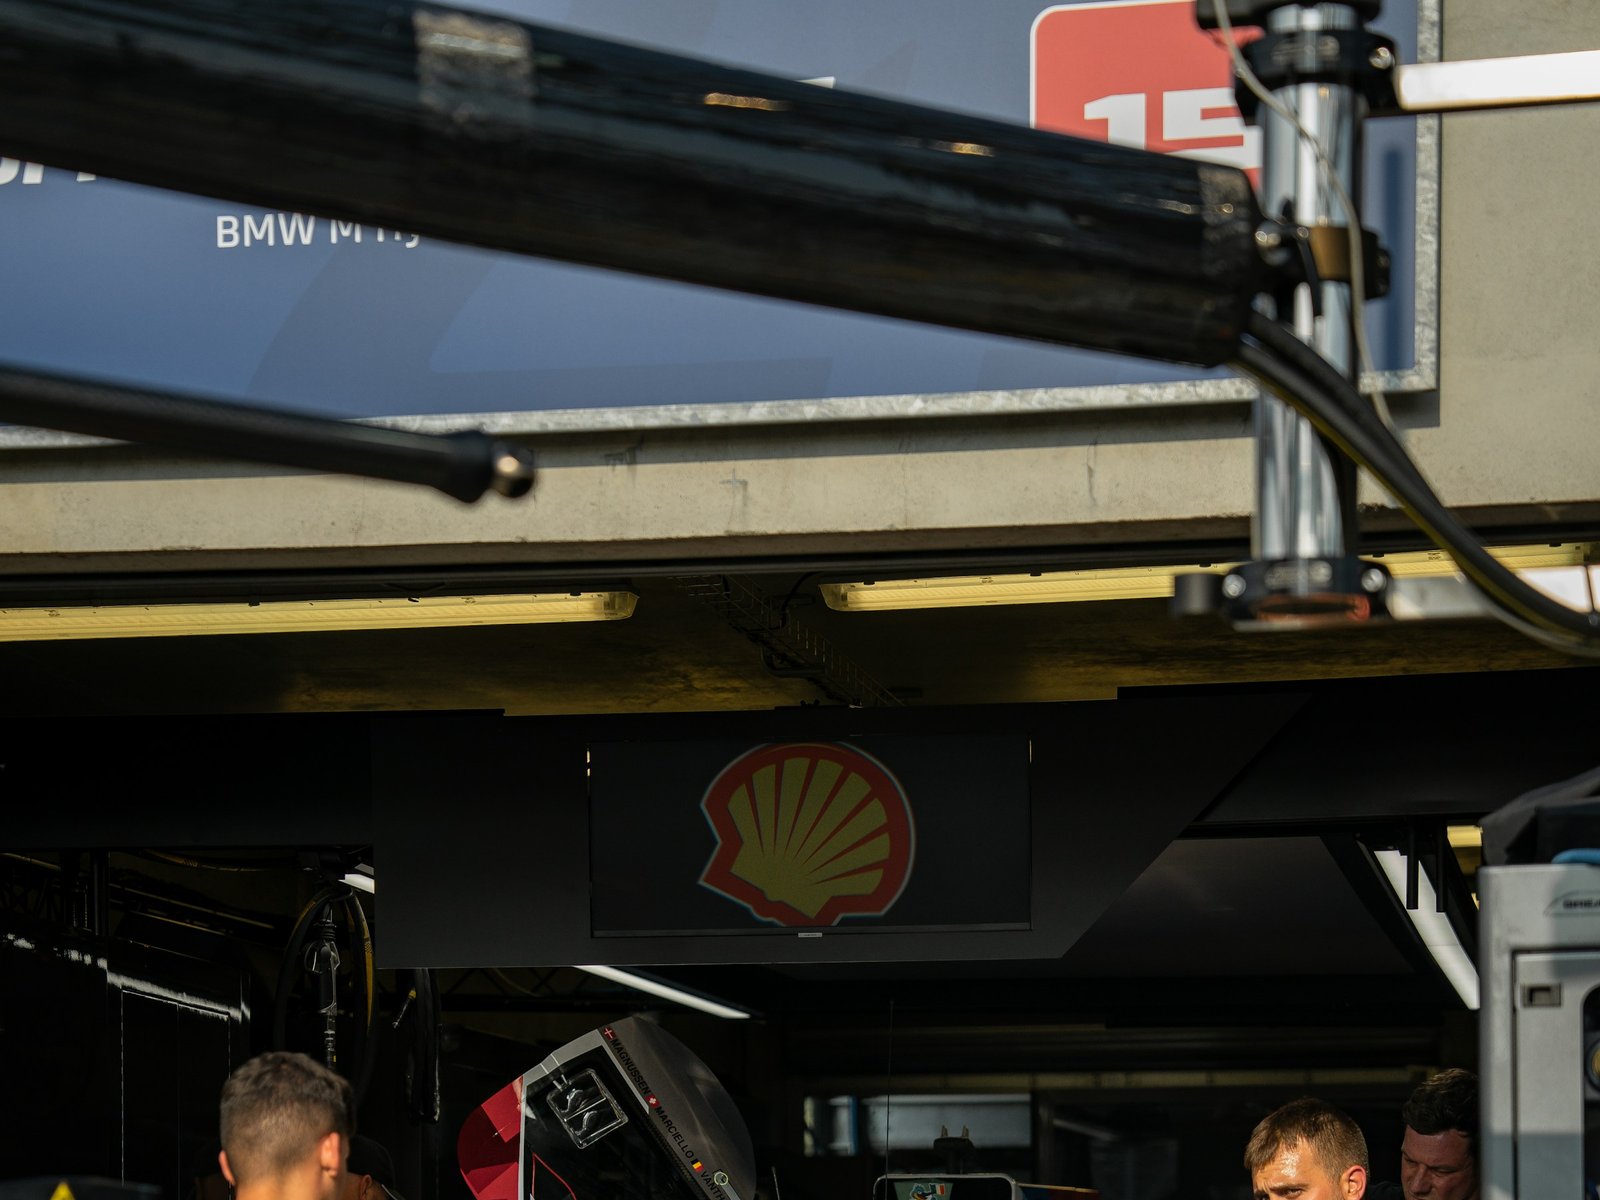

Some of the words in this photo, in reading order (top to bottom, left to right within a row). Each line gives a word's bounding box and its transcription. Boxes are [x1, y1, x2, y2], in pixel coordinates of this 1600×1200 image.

[1084, 87, 1263, 170] 15
[216, 211, 316, 249] BMW
[330, 219, 362, 244] M
[610, 1038, 652, 1096] MAGNUSSEN
[654, 1105, 695, 1160] MARCIELLO
